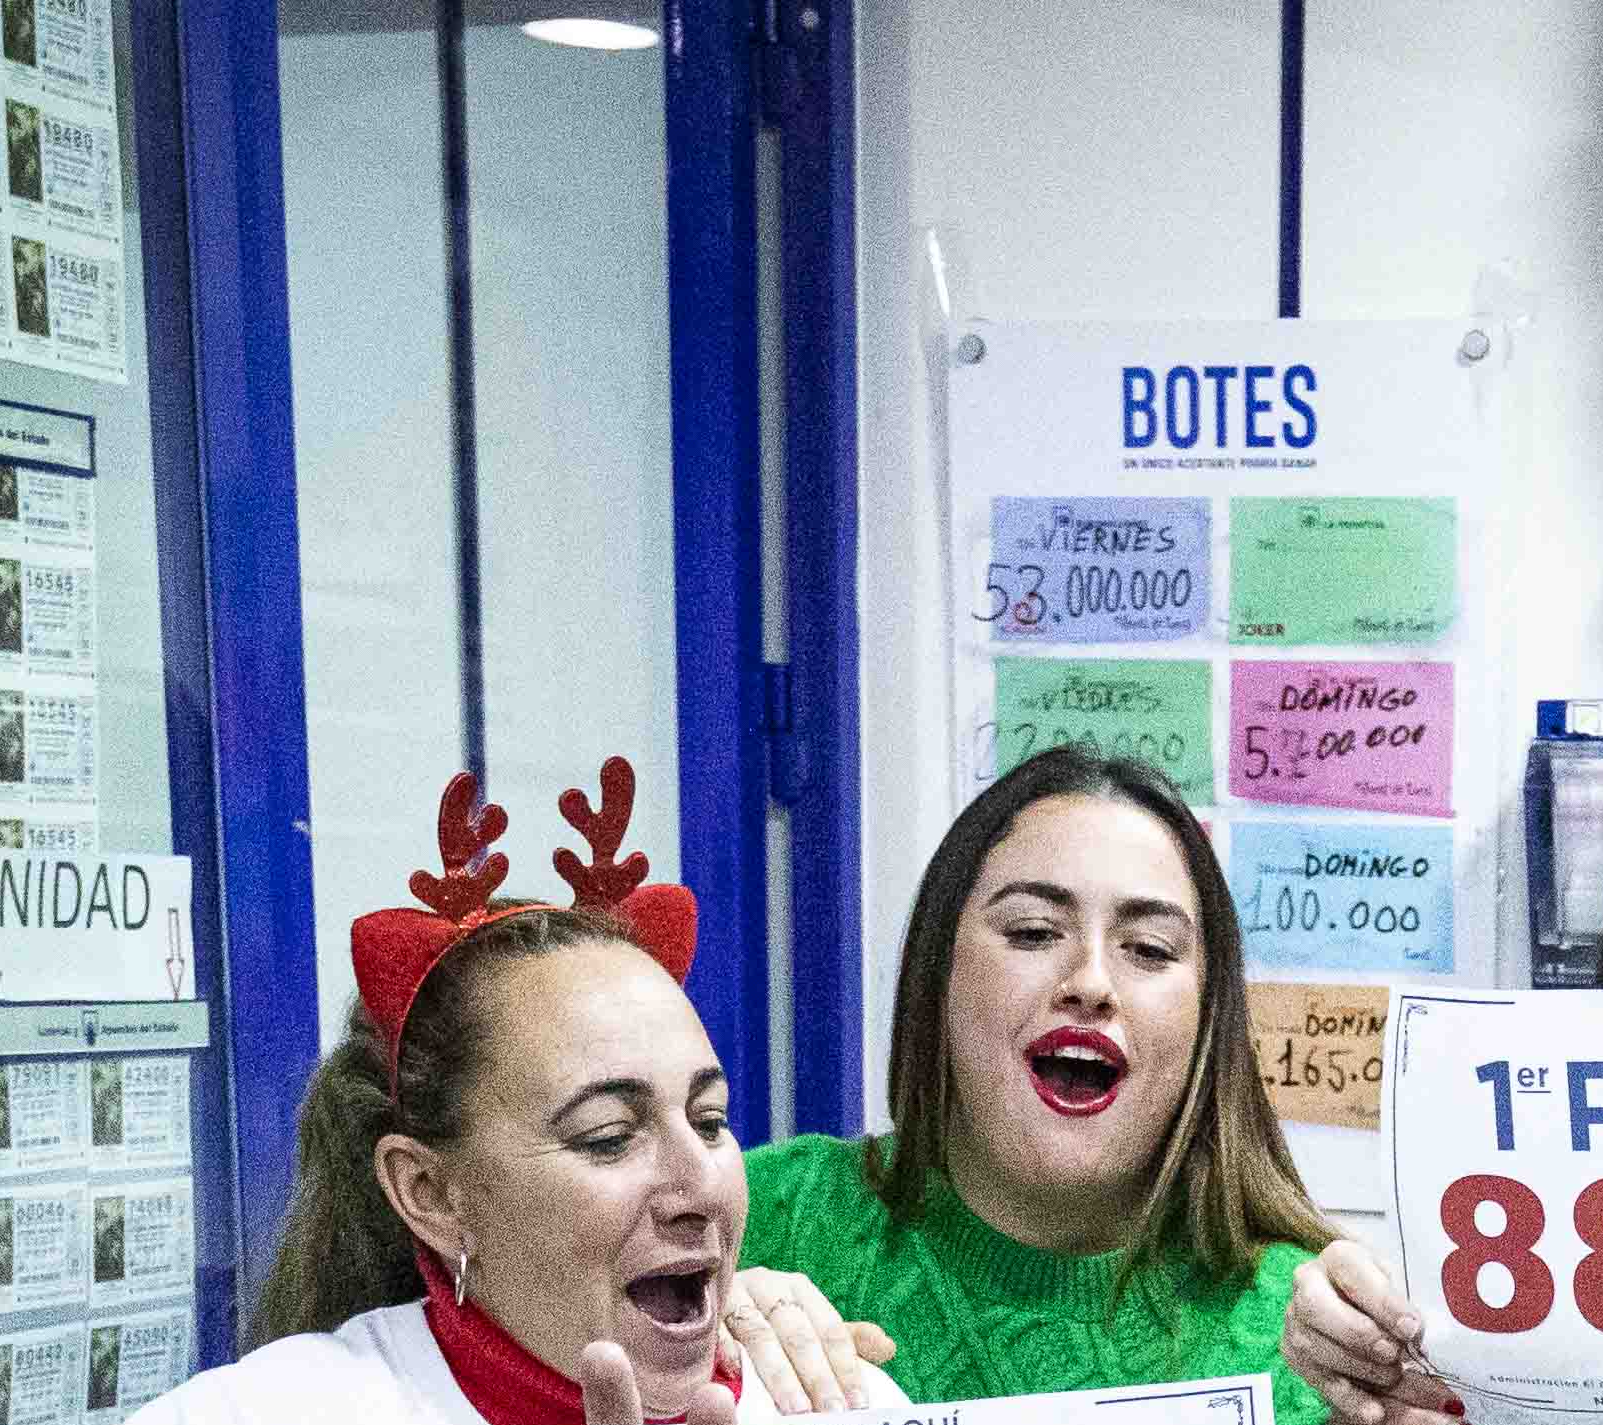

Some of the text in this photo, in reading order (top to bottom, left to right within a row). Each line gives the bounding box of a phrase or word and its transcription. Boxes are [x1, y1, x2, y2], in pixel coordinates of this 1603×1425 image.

[1122, 364, 1318, 449] BOTES
[1040, 526, 1177, 554] VIERNES
[1280, 683, 1419, 713] DOMINGO
[1305, 853, 1429, 879] DOMINGO
[1249, 886, 1422, 935] 100.000
[1475, 1060, 1552, 1153] 1er
